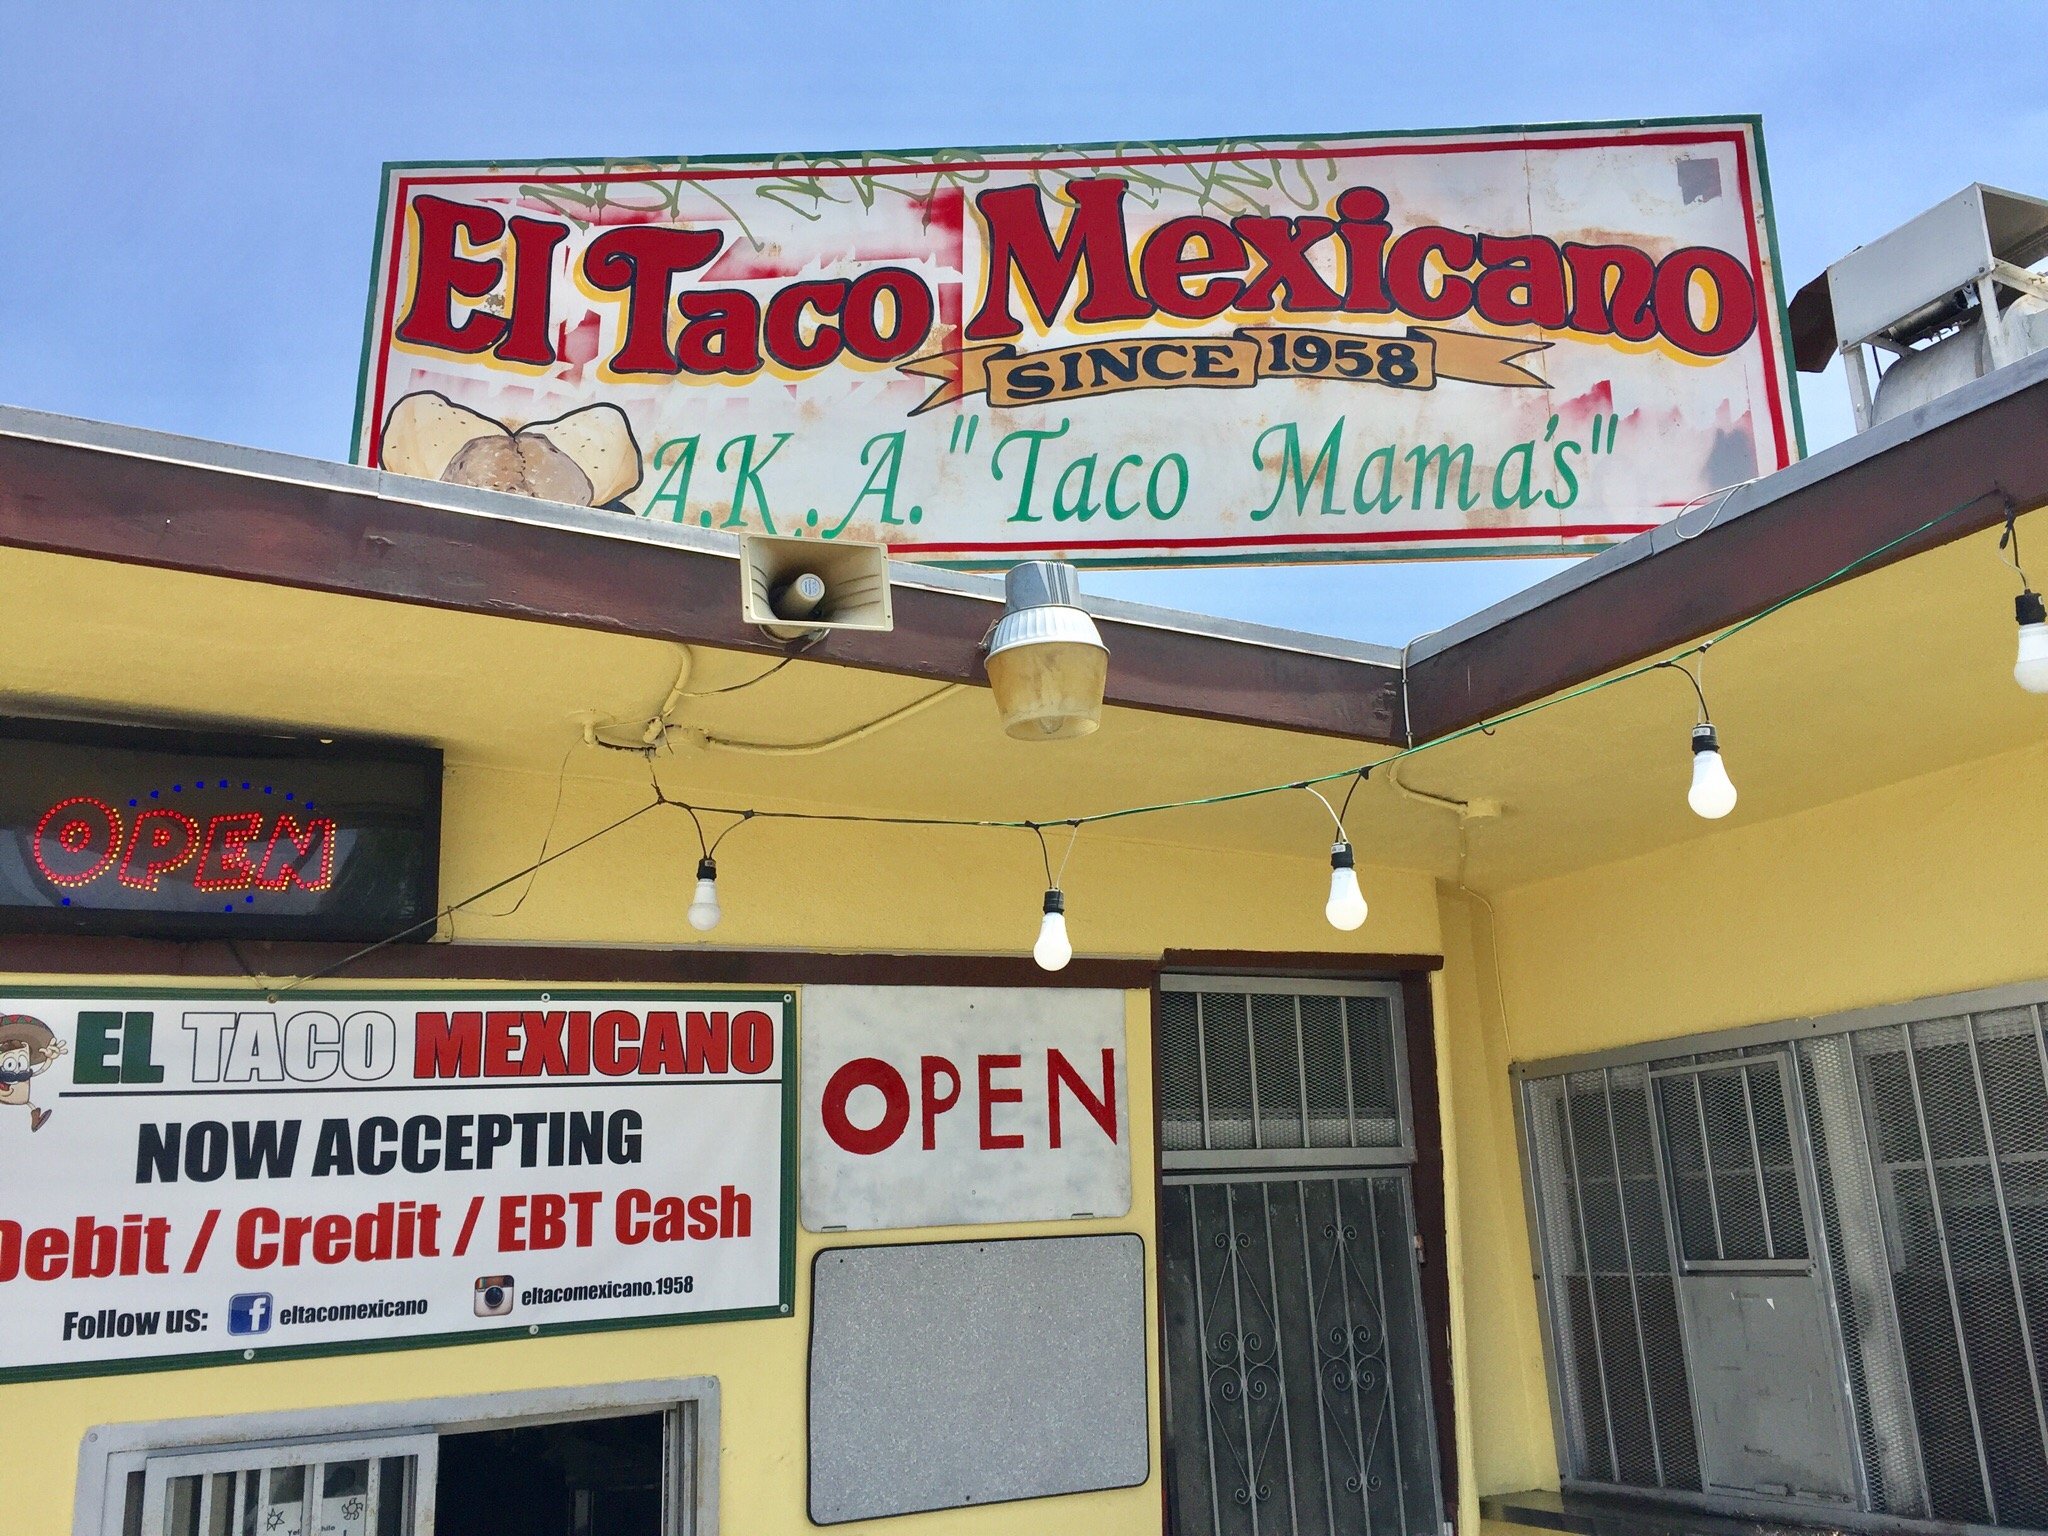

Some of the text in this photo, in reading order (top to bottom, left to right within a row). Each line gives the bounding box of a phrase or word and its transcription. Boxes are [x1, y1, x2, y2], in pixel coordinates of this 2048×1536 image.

[395, 194, 569, 374] El
[580, 226, 934, 377] Taco
[966, 178, 1758, 372] Mexicano
[1006, 333, 1417, 400] SINCE 1958
[33, 797, 336, 892] OPEN
[72, 1009, 774, 1084] EL TACO MEXICANO
[821, 1048, 1118, 1155] OPEN
[135, 1108, 643, 1184] NOW ACCEPTING
[183, 1209, 222, 1274] /
[235, 1199, 442, 1270] Credit
[451, 1195, 485, 1257] /
[497, 1190, 603, 1253] EBT
[614, 1184, 752, 1246] Cash
[62, 1311, 160, 1341] Follow
[165, 1309, 209, 1334] us:
[279, 1298, 429, 1325] eltacomexicano
[520, 1275, 695, 1306] eltacomexicano.1958
